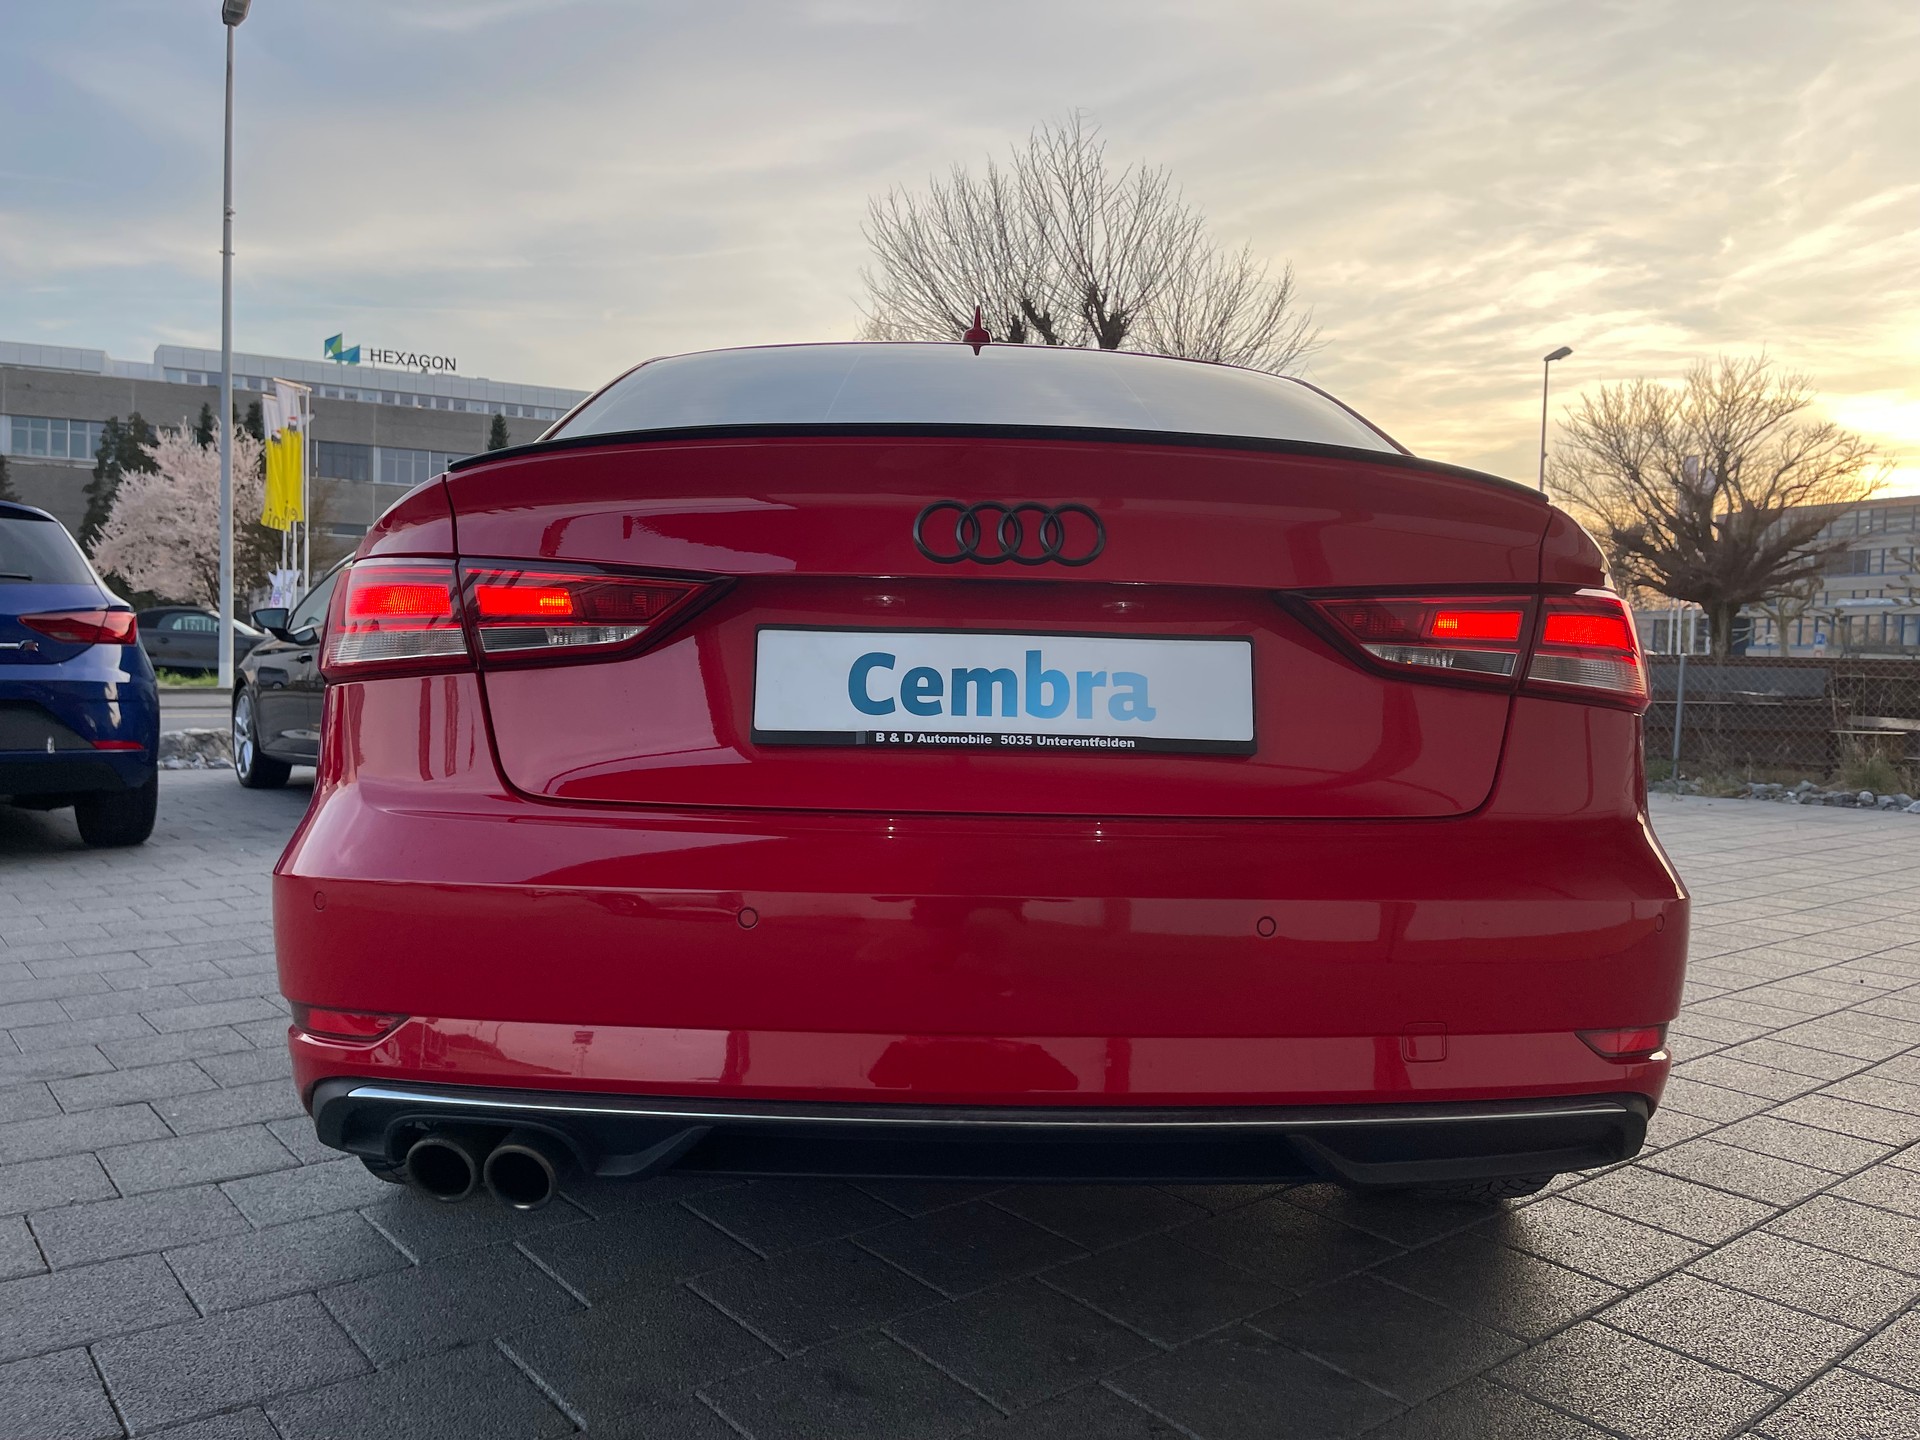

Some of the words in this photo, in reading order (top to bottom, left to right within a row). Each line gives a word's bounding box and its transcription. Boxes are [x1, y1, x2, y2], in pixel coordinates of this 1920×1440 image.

[370, 348, 456, 371] HEXAGON
[847, 649, 1157, 722] Cembra
[875, 732, 886, 743] B
[889, 732, 900, 743] &
[904, 732, 914, 743] D
[917, 733, 993, 745] Automobile
[1000, 734, 1033, 746] 5035
[1036, 735, 1136, 748] Unterentfelden
